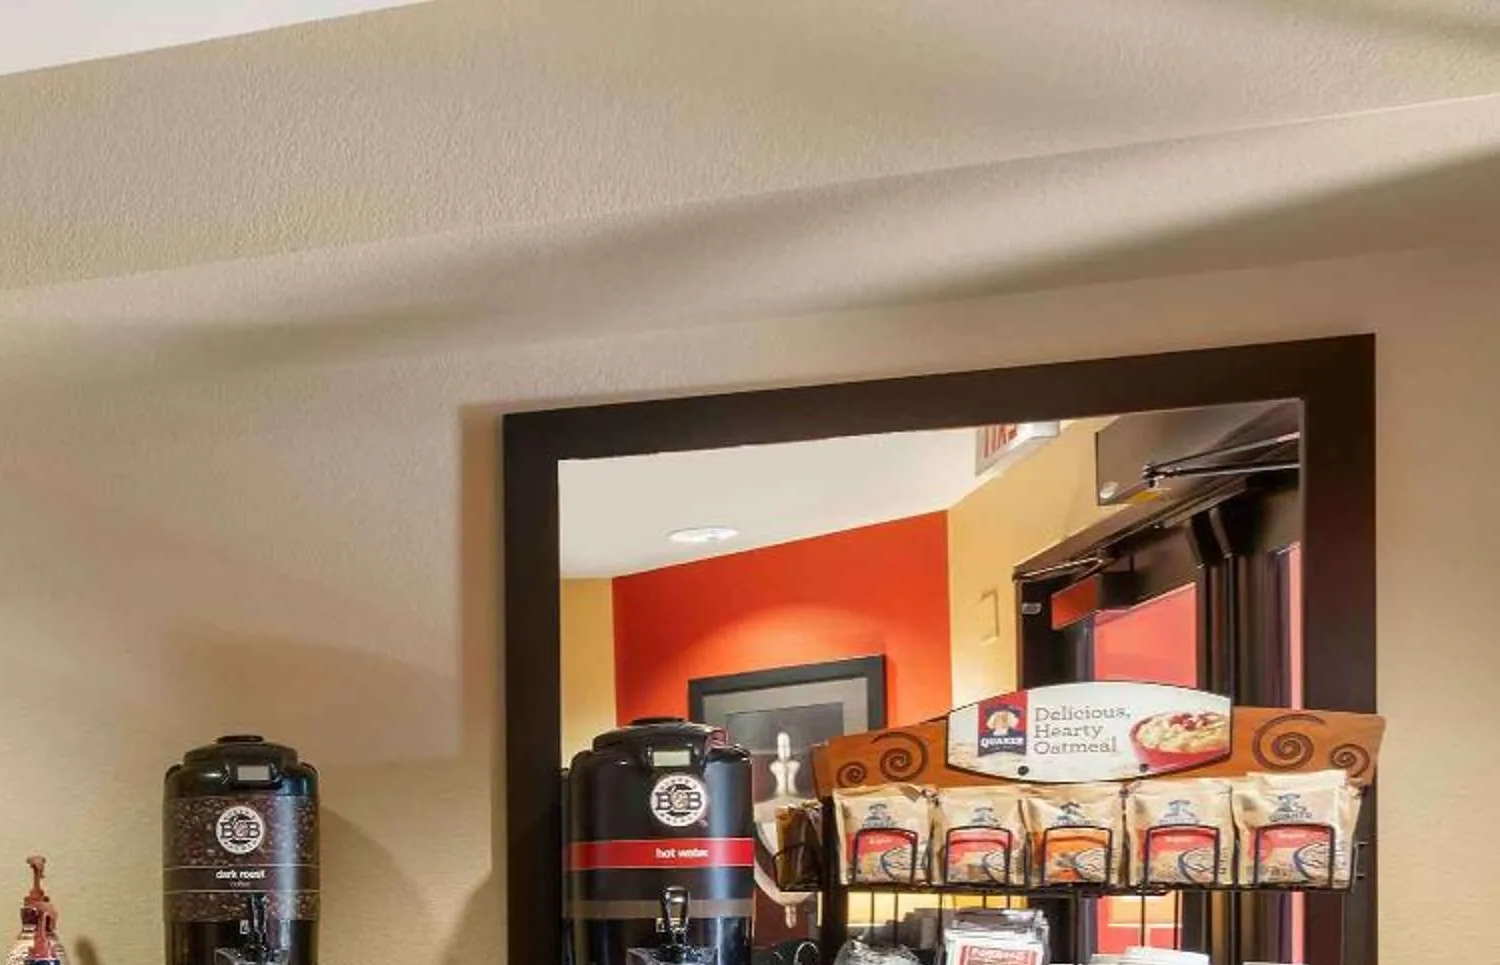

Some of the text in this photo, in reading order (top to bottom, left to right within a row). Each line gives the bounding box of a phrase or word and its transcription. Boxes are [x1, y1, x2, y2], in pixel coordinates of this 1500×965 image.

[1034, 704, 1131, 721] Delicious,
[1033, 723, 1104, 739] Hearty
[980, 736, 1025, 749] QUAKER
[1033, 736, 1117, 755] Oatmeal
[656, 848, 676, 858] hot
[216, 869, 265, 879] dark roast
